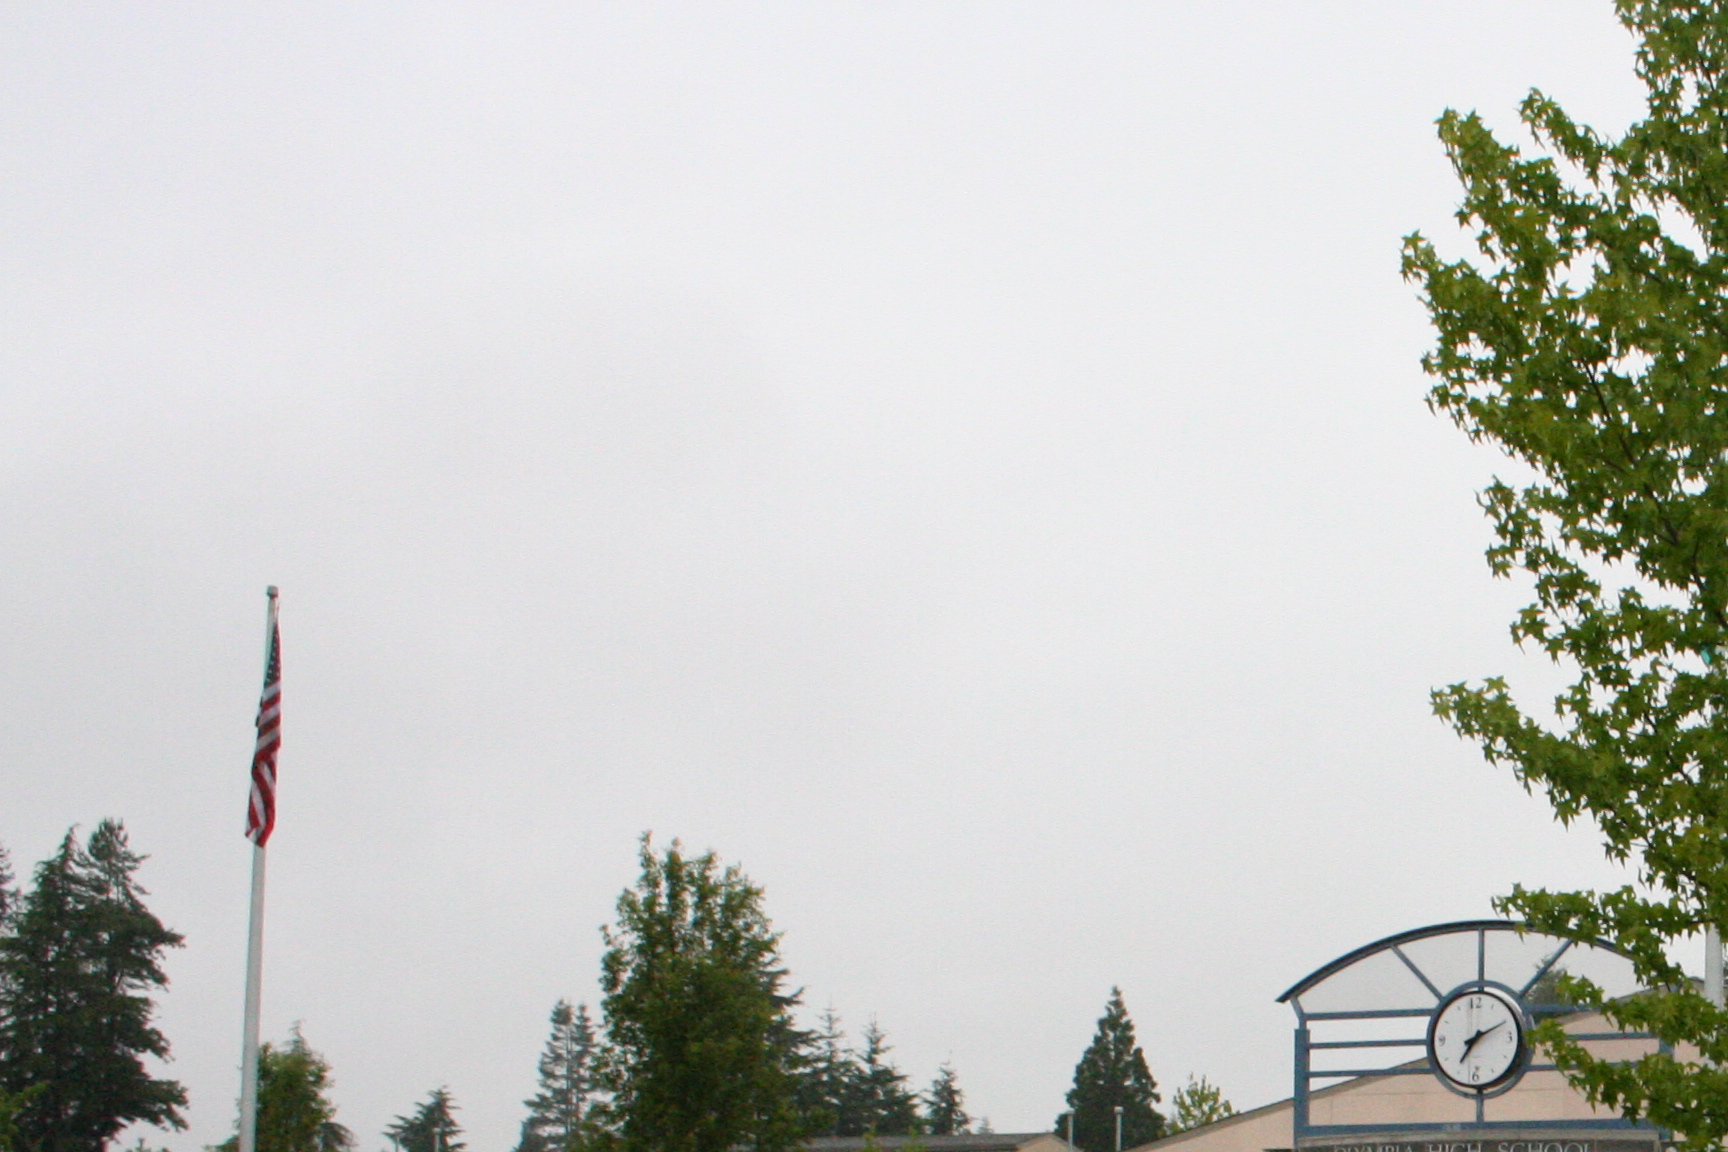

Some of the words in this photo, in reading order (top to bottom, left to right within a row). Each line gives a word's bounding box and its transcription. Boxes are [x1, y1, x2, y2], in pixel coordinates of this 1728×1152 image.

[1469, 997, 1482, 1009] 12
[1438, 1035, 1446, 1047] 9
[1507, 1031, 1513, 1043] 3
[1471, 1071, 1480, 1082] 6
